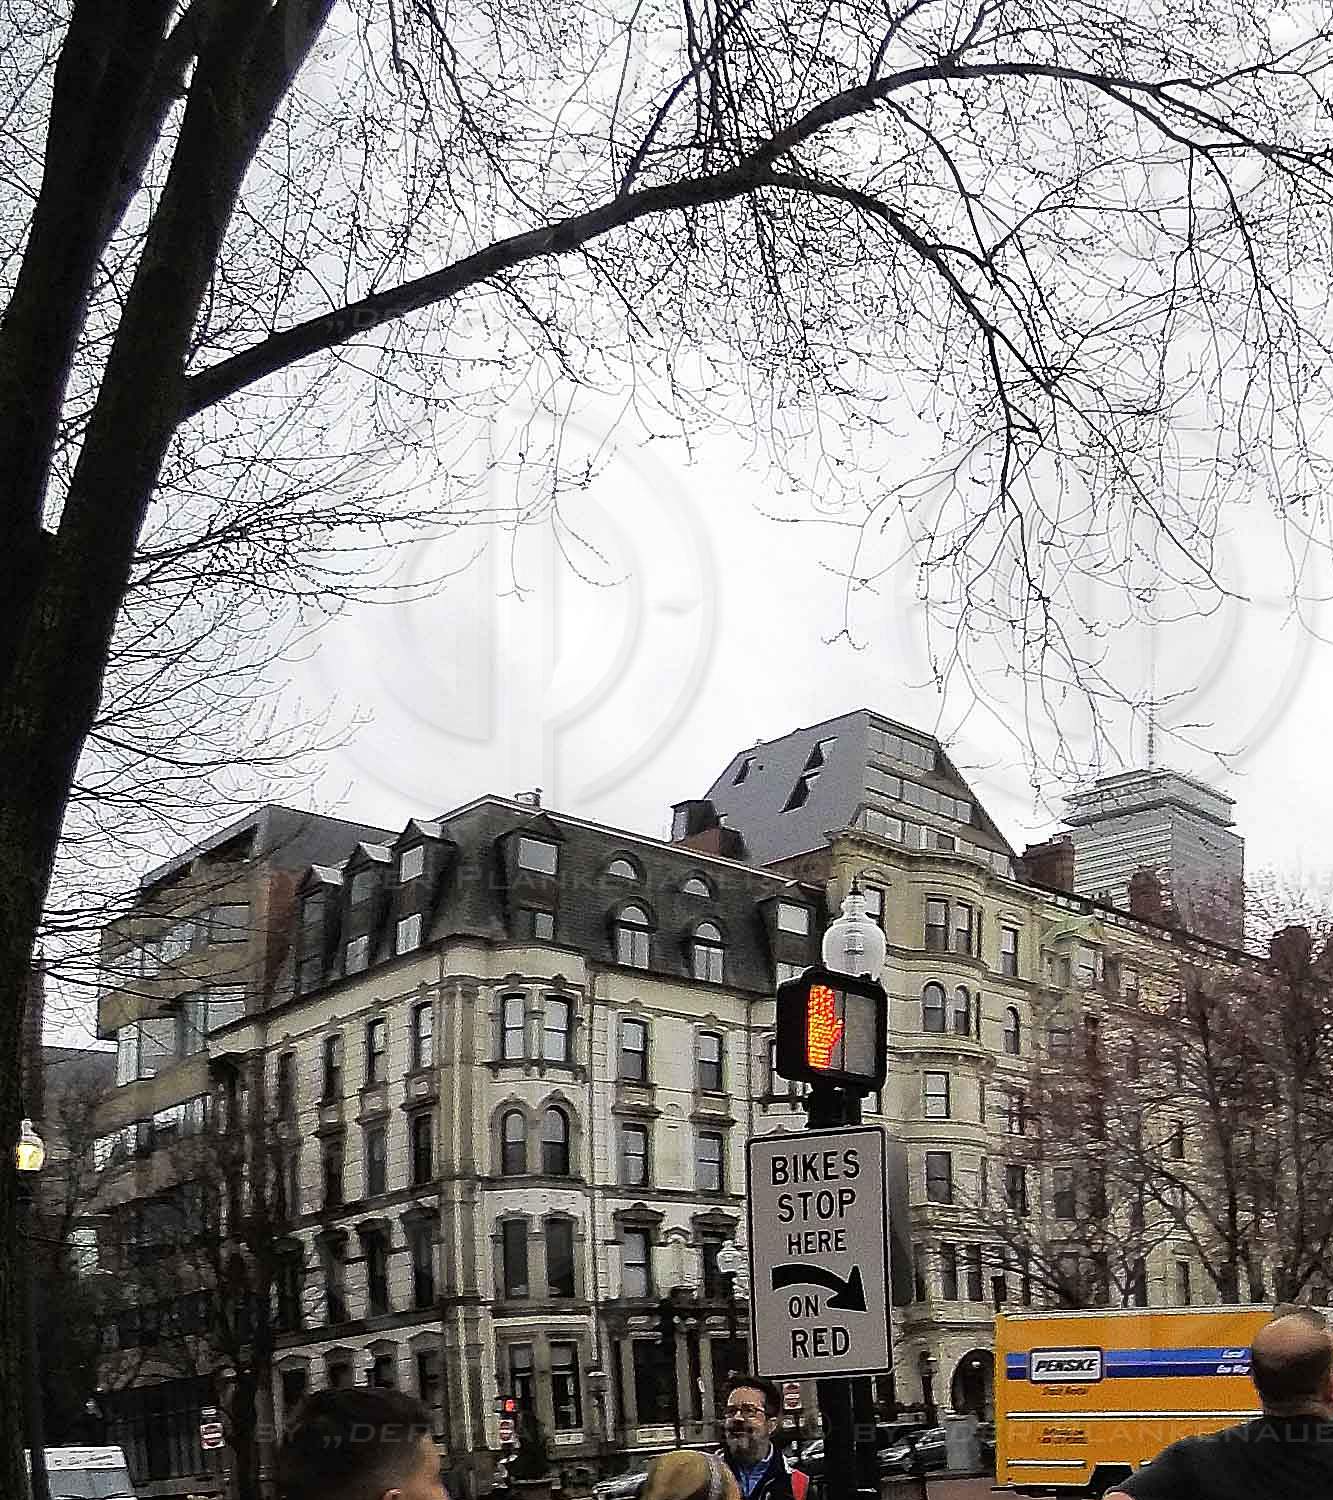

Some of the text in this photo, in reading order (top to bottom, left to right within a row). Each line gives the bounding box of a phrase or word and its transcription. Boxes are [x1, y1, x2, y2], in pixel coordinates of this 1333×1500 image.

[771, 1150, 860, 1186] BIKES
[777, 1188, 856, 1223] STOP
[787, 1229, 847, 1255] HERE
[788, 1295, 819, 1319] ON
[791, 1326, 850, 1359] RED
[1034, 1358, 1098, 1373] PENSKE
